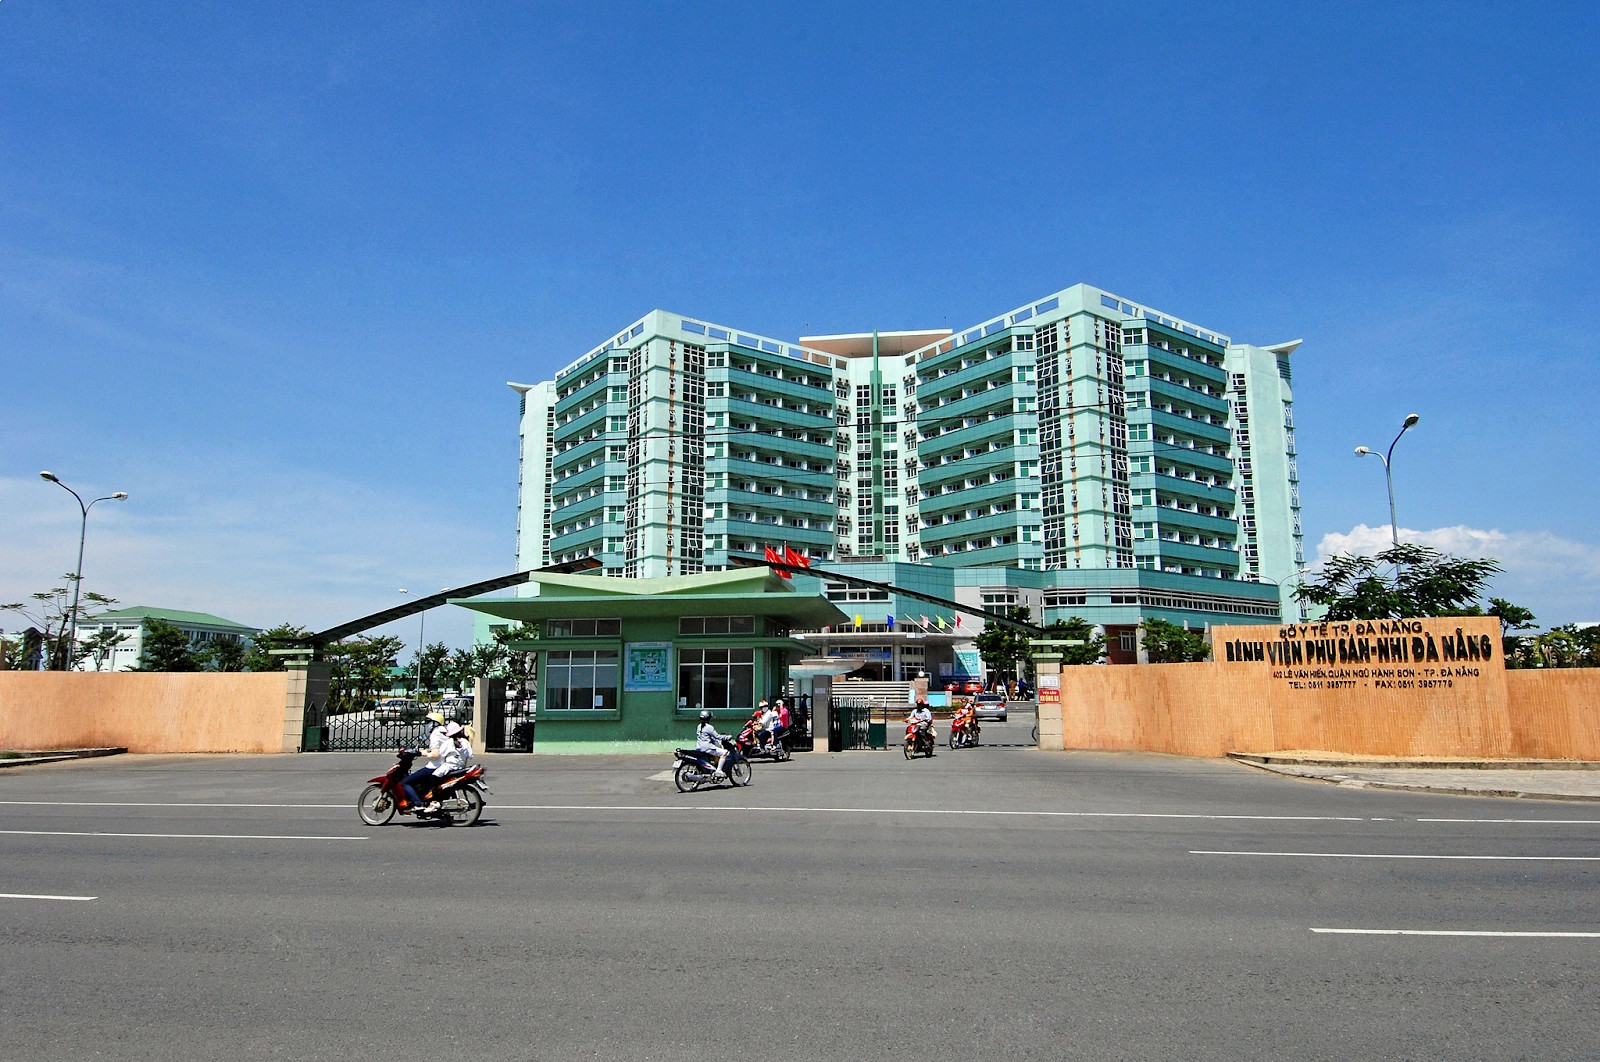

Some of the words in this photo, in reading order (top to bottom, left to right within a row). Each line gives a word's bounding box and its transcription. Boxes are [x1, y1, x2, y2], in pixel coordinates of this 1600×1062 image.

[1299, 626, 1308, 638] Y
[1311, 622, 1328, 637] TẾ
[1356, 621, 1376, 635] ĐÀ
[1266, 638, 1303, 668] VIỆN
[1305, 638, 1337, 668] PHỤ
[1412, 631, 1440, 662] ĐÀ
[1442, 627, 1492, 662] NẴNG
[1283, 669, 1293, 678] LÊ
[1294, 669, 1309, 679] VĂN
[1328, 668, 1351, 680] QUẬN
[1371, 667, 1395, 678] HÀNH
[1397, 668, 1415, 678] SƠN
[1440, 666, 1453, 677] ĐÀ
[1455, 665, 1480, 677] NẴNG
[1289, 681, 1306, 689] TEL:
[1308, 681, 1323, 689] 0511
[1375, 680, 1396, 689] FAX:
[1398, 680, 1415, 688] 0511
